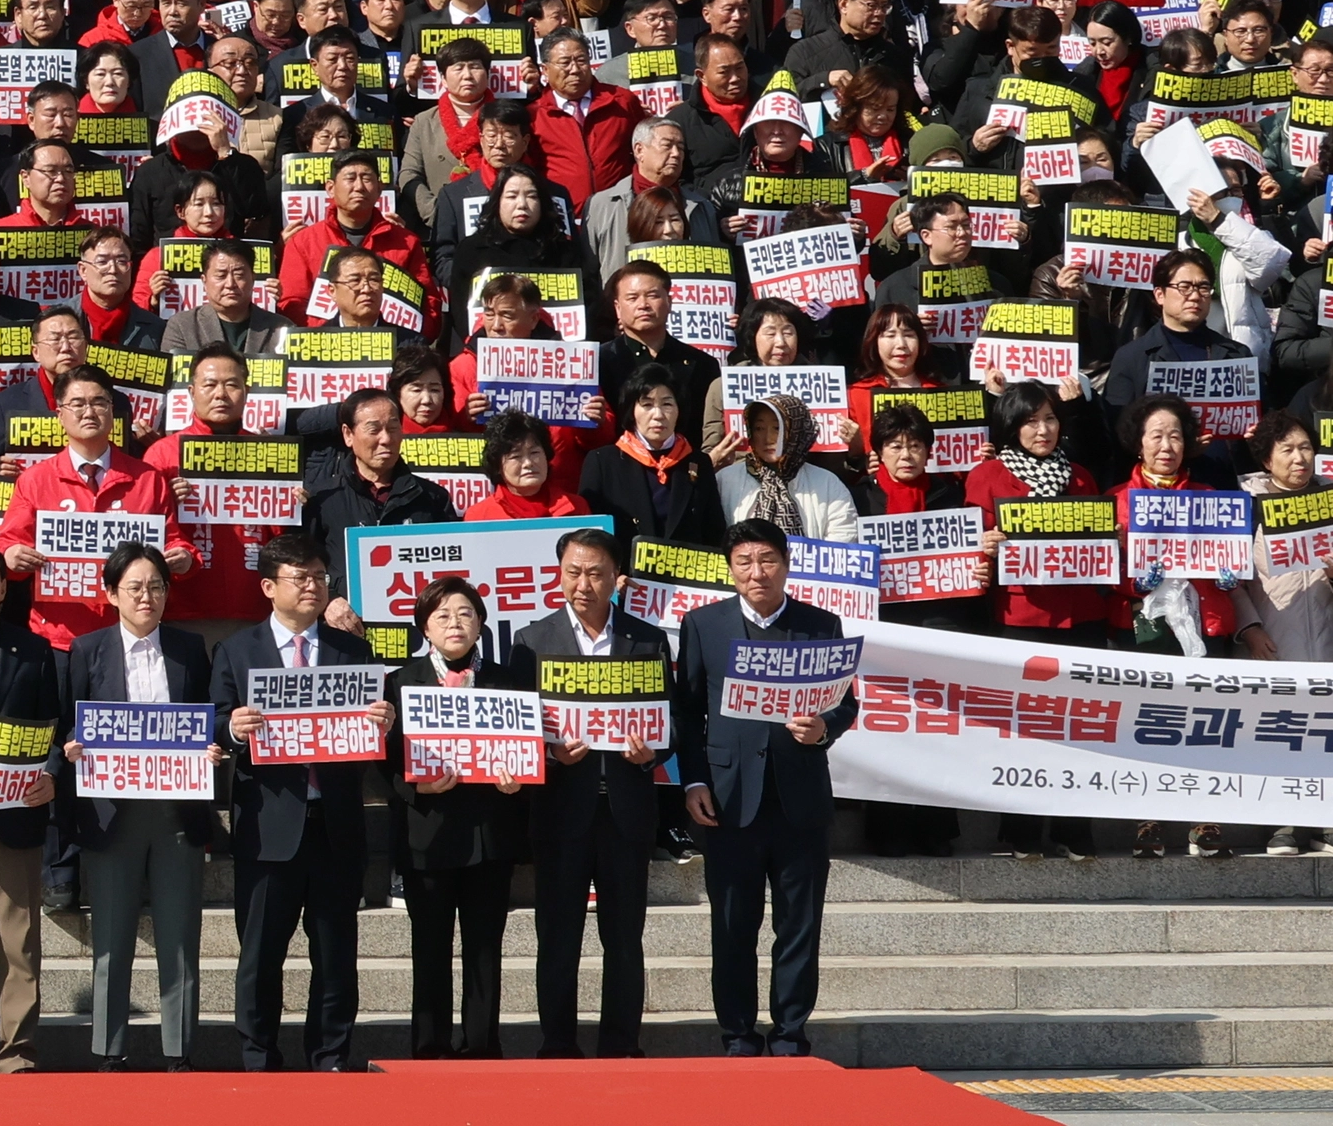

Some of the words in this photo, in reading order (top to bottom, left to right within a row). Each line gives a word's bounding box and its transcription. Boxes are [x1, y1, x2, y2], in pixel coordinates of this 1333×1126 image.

[745, 238, 799, 275] 국민분열
[801, 228, 855, 266] 조장하는
[1007, 342, 1074, 380] 추진하라
[999, 501, 1115, 534] 대구경북행정통합특별법
[398, 545, 462, 564] 국민의힘
[1043, 542, 1112, 579] 추진하라
[1070, 662, 1173, 689] 국민의힘
[1185, 671, 1297, 695] 수성구을
[82, 709, 141, 743] 광주전남
[146, 709, 207, 743] 다퍼주고
[409, 693, 467, 732] 국민분열
[474, 695, 535, 732] 조장하는
[1133, 702, 1243, 748] 통과
[1254, 709, 1333, 752] 촉구
[991, 766, 1054, 789] 2026.
[1061, 769, 1082, 789] 3.
[1157, 773, 1200, 796] 오후
[1208, 775, 1243, 798] 2시
[1281, 778, 1324, 801] 국회
